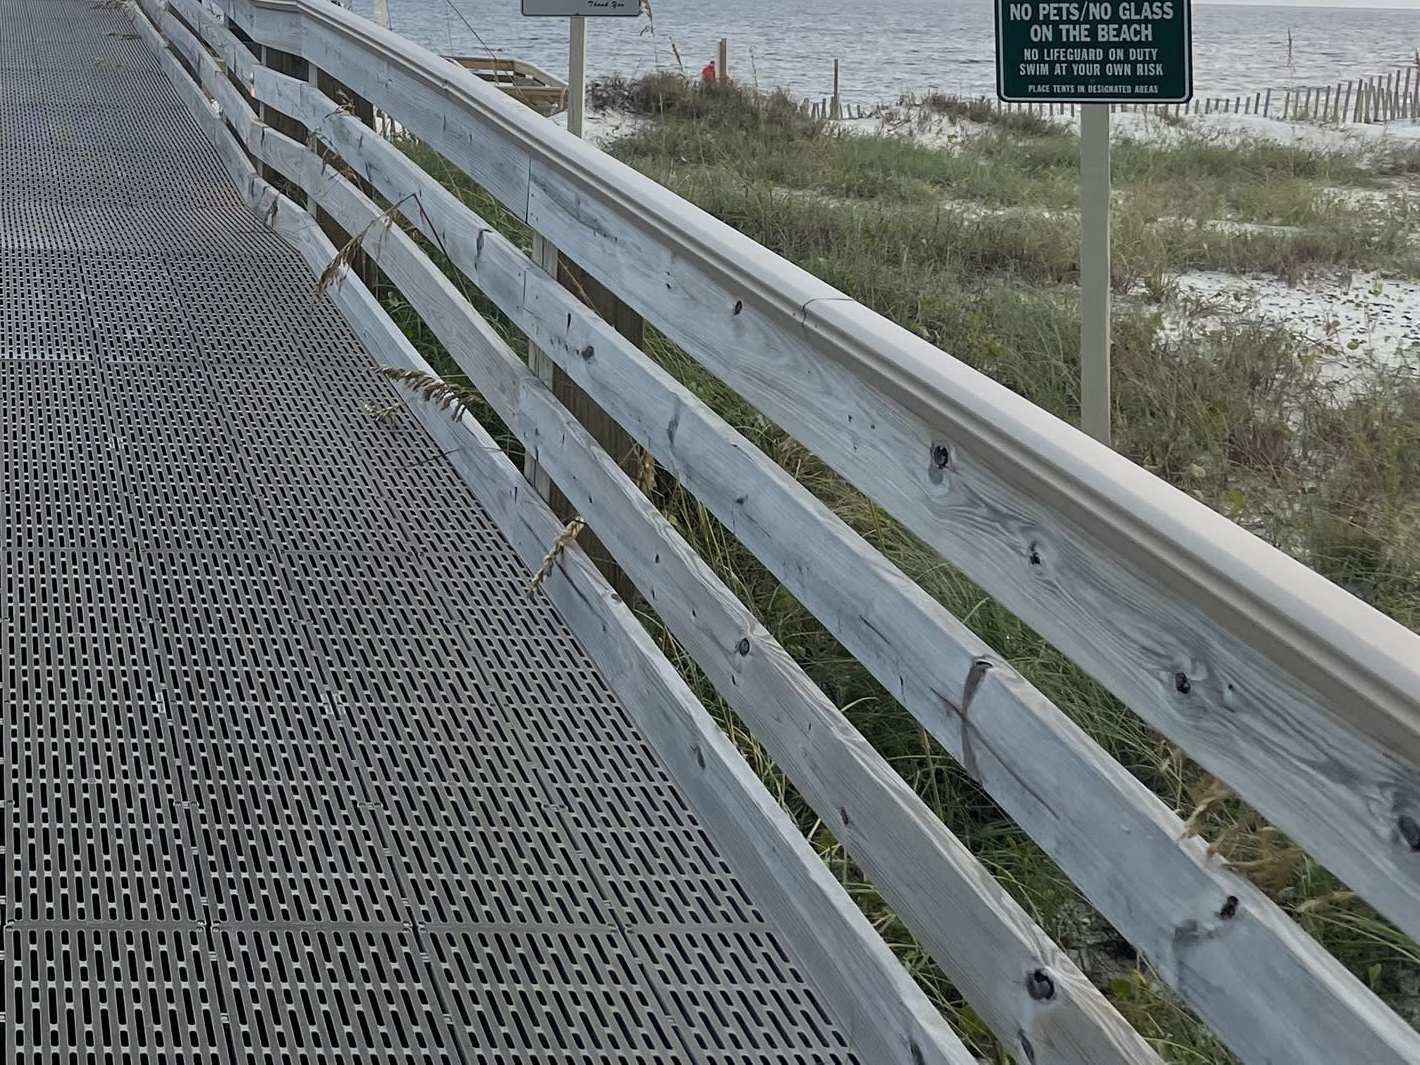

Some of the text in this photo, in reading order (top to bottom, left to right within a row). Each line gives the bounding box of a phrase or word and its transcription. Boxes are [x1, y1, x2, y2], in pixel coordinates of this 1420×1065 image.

[587, 0, 625, 9] Thank You
[1009, 0, 1174, 22] NO PETS/NO GLASS
[1030, 23, 1153, 42] ON THE BEACH
[1024, 48, 1158, 61] NO LIFEGUARD ON DUTY
[1019, 63, 1164, 76] SWIM AT YOUR OWN RISK
[1028, 84, 1158, 94] PLACE TENTS IN DESIGNATED AREAS
